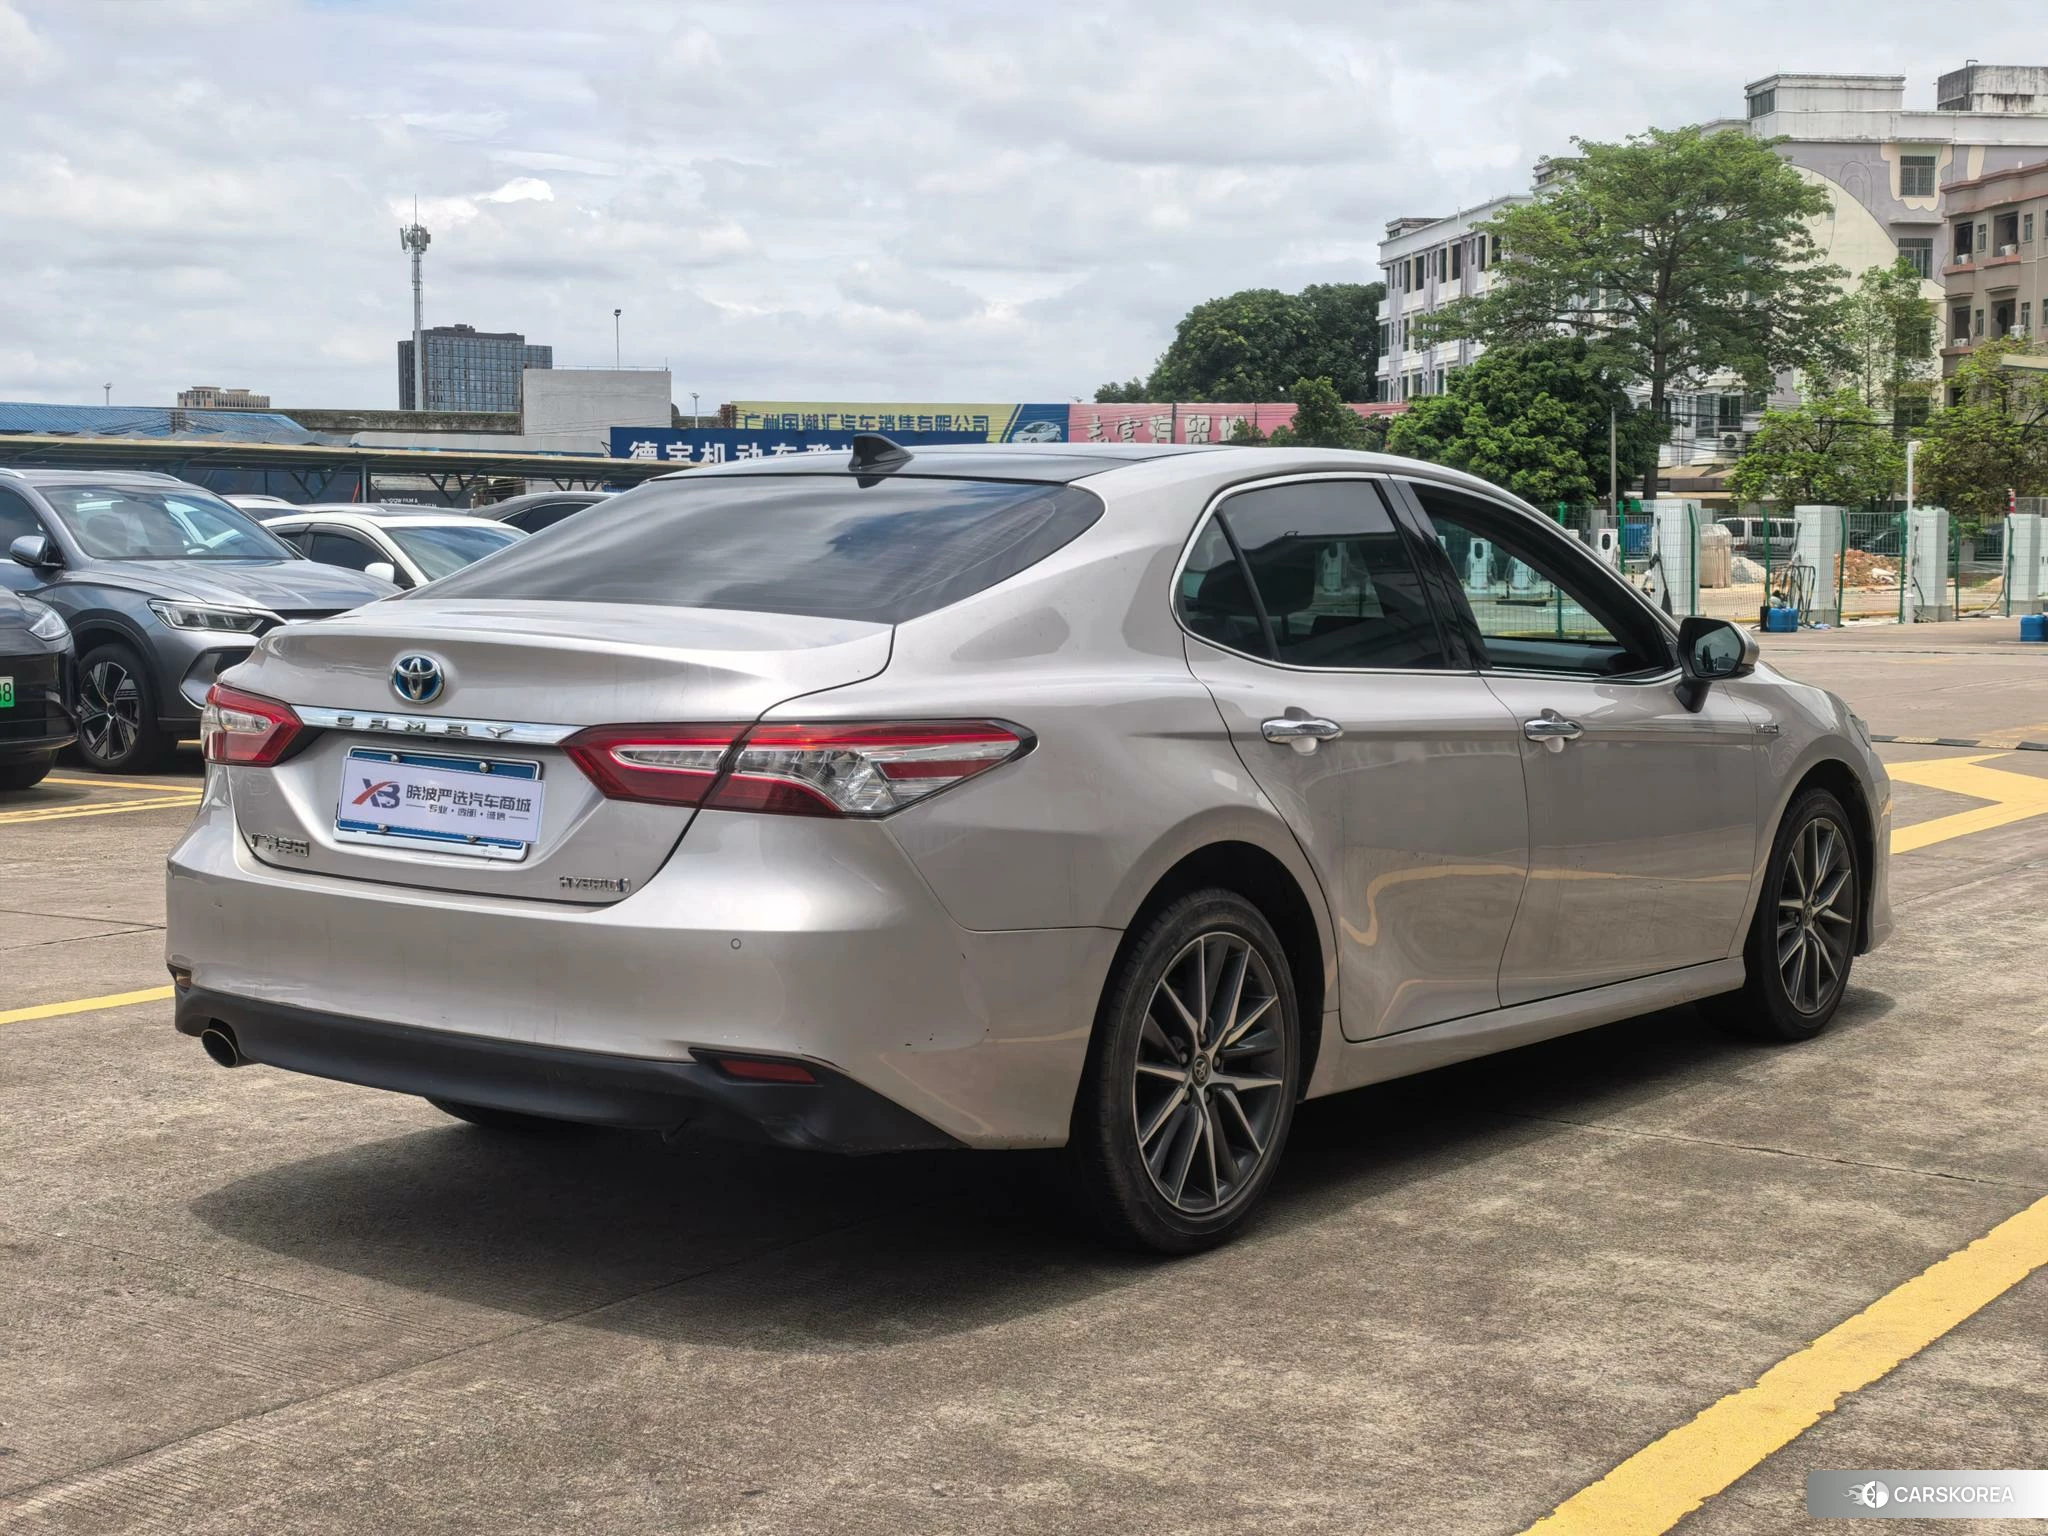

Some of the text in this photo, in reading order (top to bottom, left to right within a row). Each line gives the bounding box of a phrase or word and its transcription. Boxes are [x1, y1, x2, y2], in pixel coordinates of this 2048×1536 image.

[0, 682, 12, 702] 8
[406, 784, 532, 813] 晓波严选汽车商城
